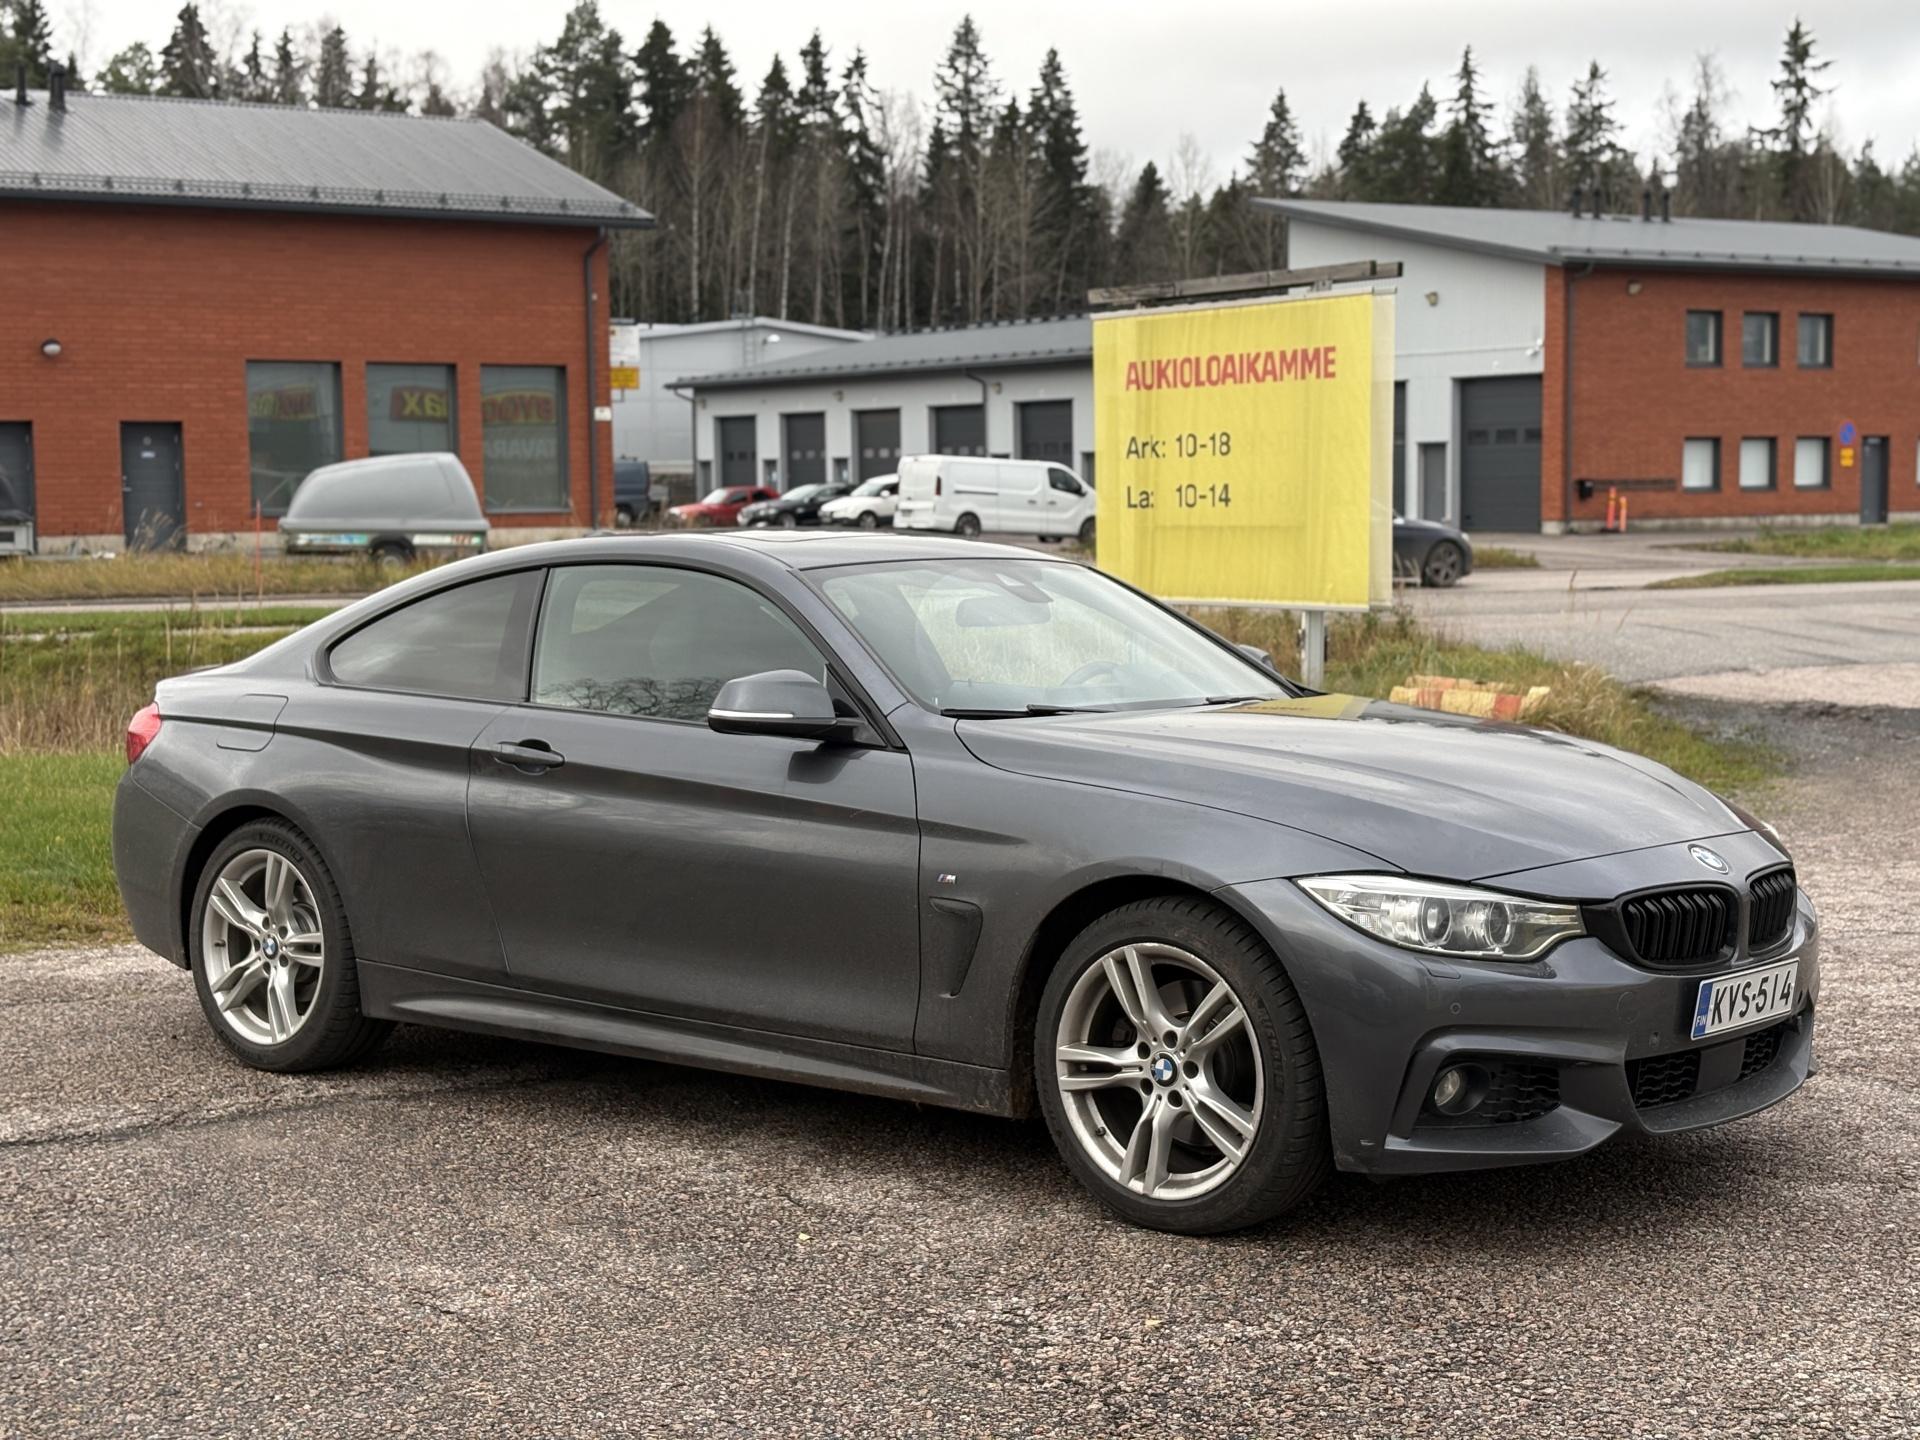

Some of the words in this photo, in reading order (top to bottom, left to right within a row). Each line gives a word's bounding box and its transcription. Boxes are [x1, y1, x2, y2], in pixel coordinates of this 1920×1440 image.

[1126, 346, 1336, 391] AUKIOLOAIKAMME
[1126, 435, 1167, 459] Ark:
[1176, 432, 1231, 457] 10-18
[1126, 485, 1154, 509] La:
[1176, 484, 1231, 508] 10-14
